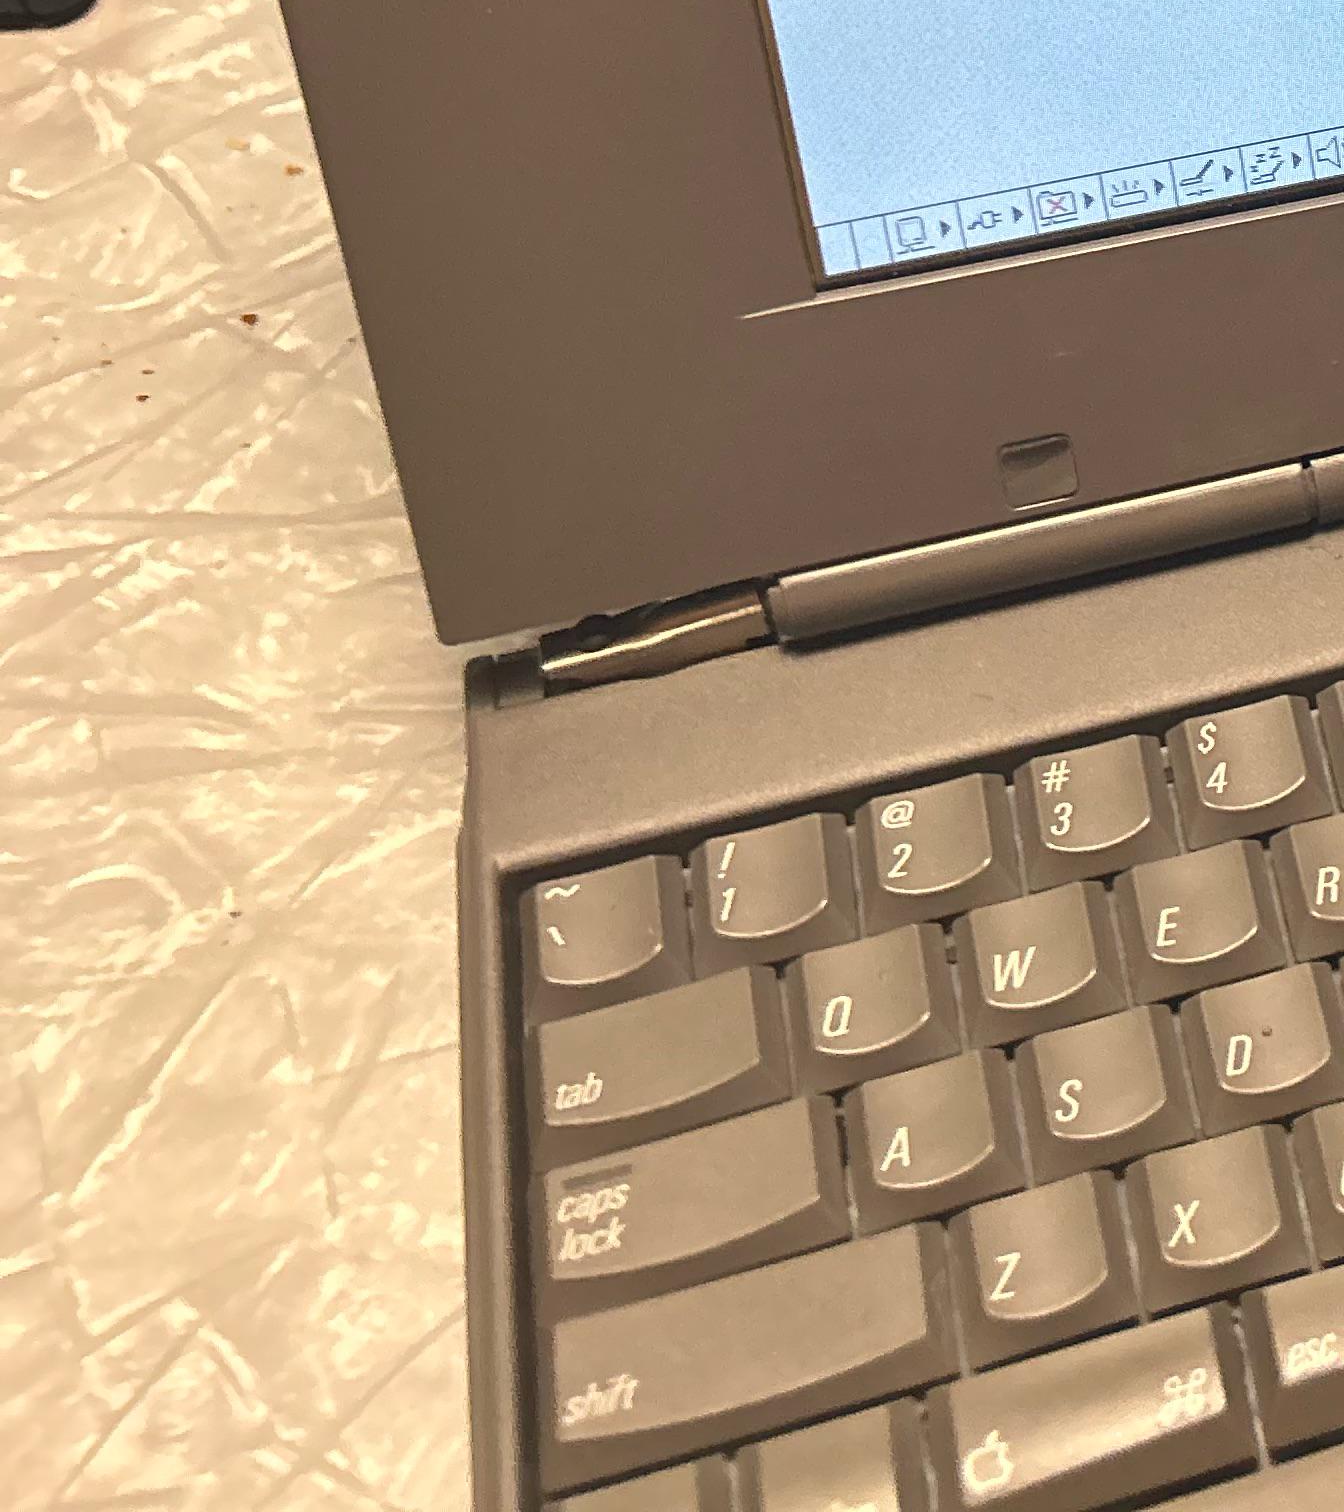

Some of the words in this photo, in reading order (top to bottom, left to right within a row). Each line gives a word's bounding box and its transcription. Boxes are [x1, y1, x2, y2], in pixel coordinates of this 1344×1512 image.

[1198, 722, 1217, 754] $
[1041, 760, 1070, 792] #
[1206, 762, 1228, 793] 4
[881, 801, 914, 829] @
[1050, 802, 1072, 835] 3
[717, 842, 735, 879] !
[888, 843, 912, 878] 2
[720, 888, 737, 922] 1
[1316, 866, 1341, 905] R
[1155, 906, 1180, 947] E
[992, 946, 1036, 991] W
[1226, 1034, 1252, 1077] D
[555, 1072, 603, 1110] tab
[1055, 1079, 1083, 1122] S
[880, 1126, 911, 1172] A
[557, 1183, 630, 1223] caps
[559, 1221, 626, 1262] lock
[1168, 1200, 1200, 1248] X
[989, 1252, 1021, 1301] Z
[1287, 1332, 1338, 1372] esc
[562, 1373, 640, 1427] shift
